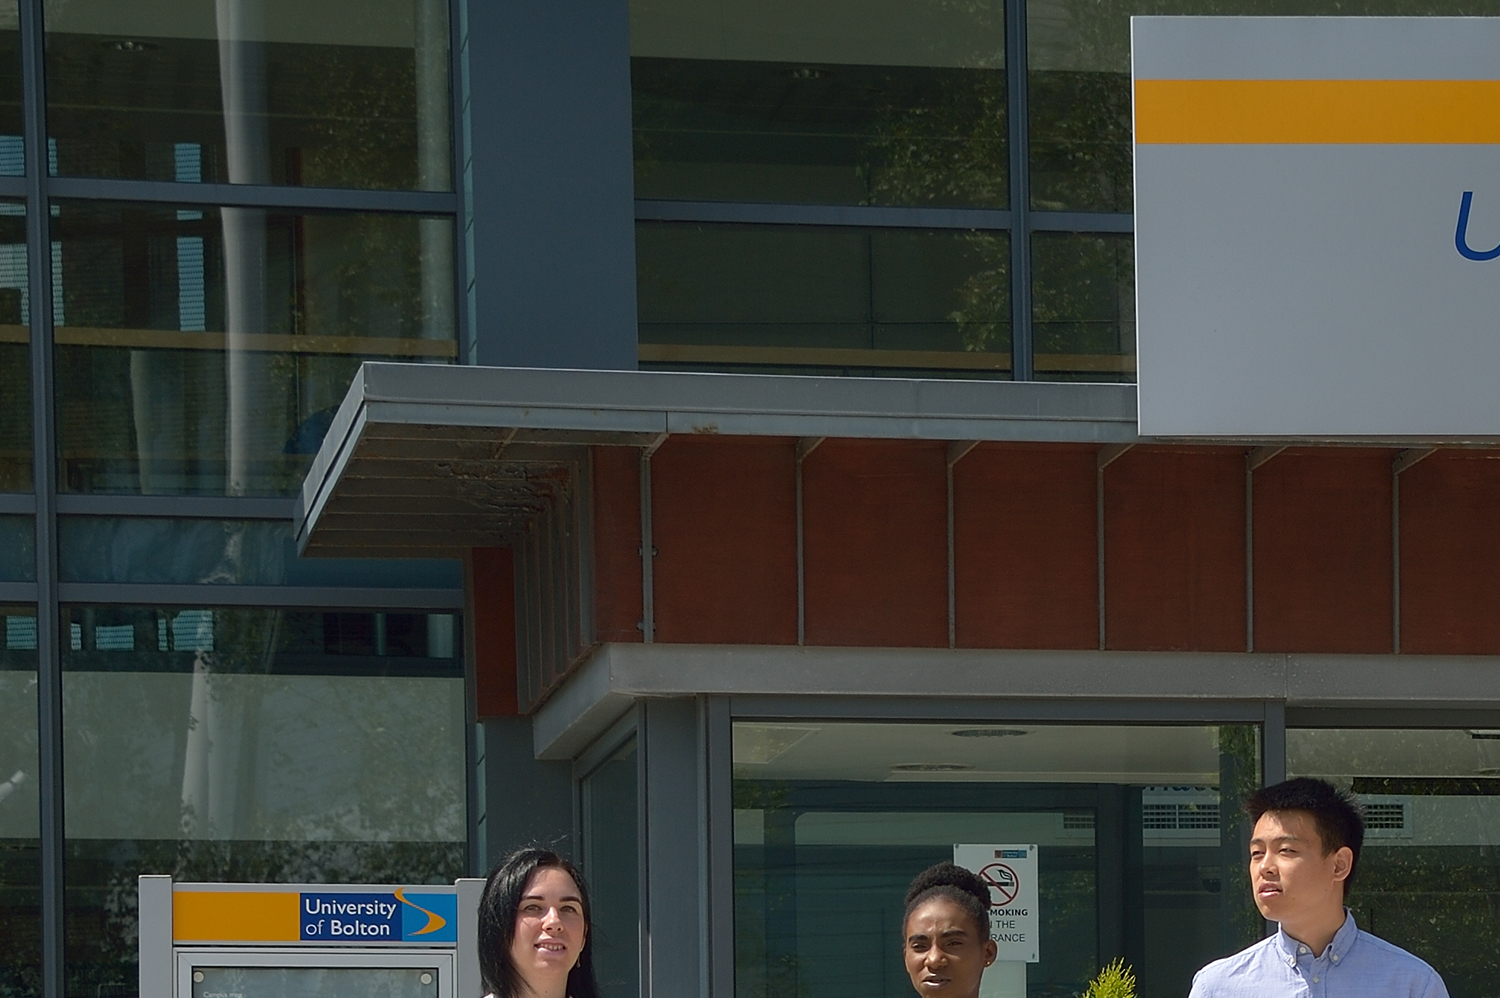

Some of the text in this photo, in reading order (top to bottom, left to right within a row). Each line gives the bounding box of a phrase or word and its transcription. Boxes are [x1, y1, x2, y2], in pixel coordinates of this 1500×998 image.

[305, 898, 397, 920] University
[305, 919, 390, 936] of Bolton
[996, 920, 1016, 929] THE
[990, 933, 1026, 942] RANCE
